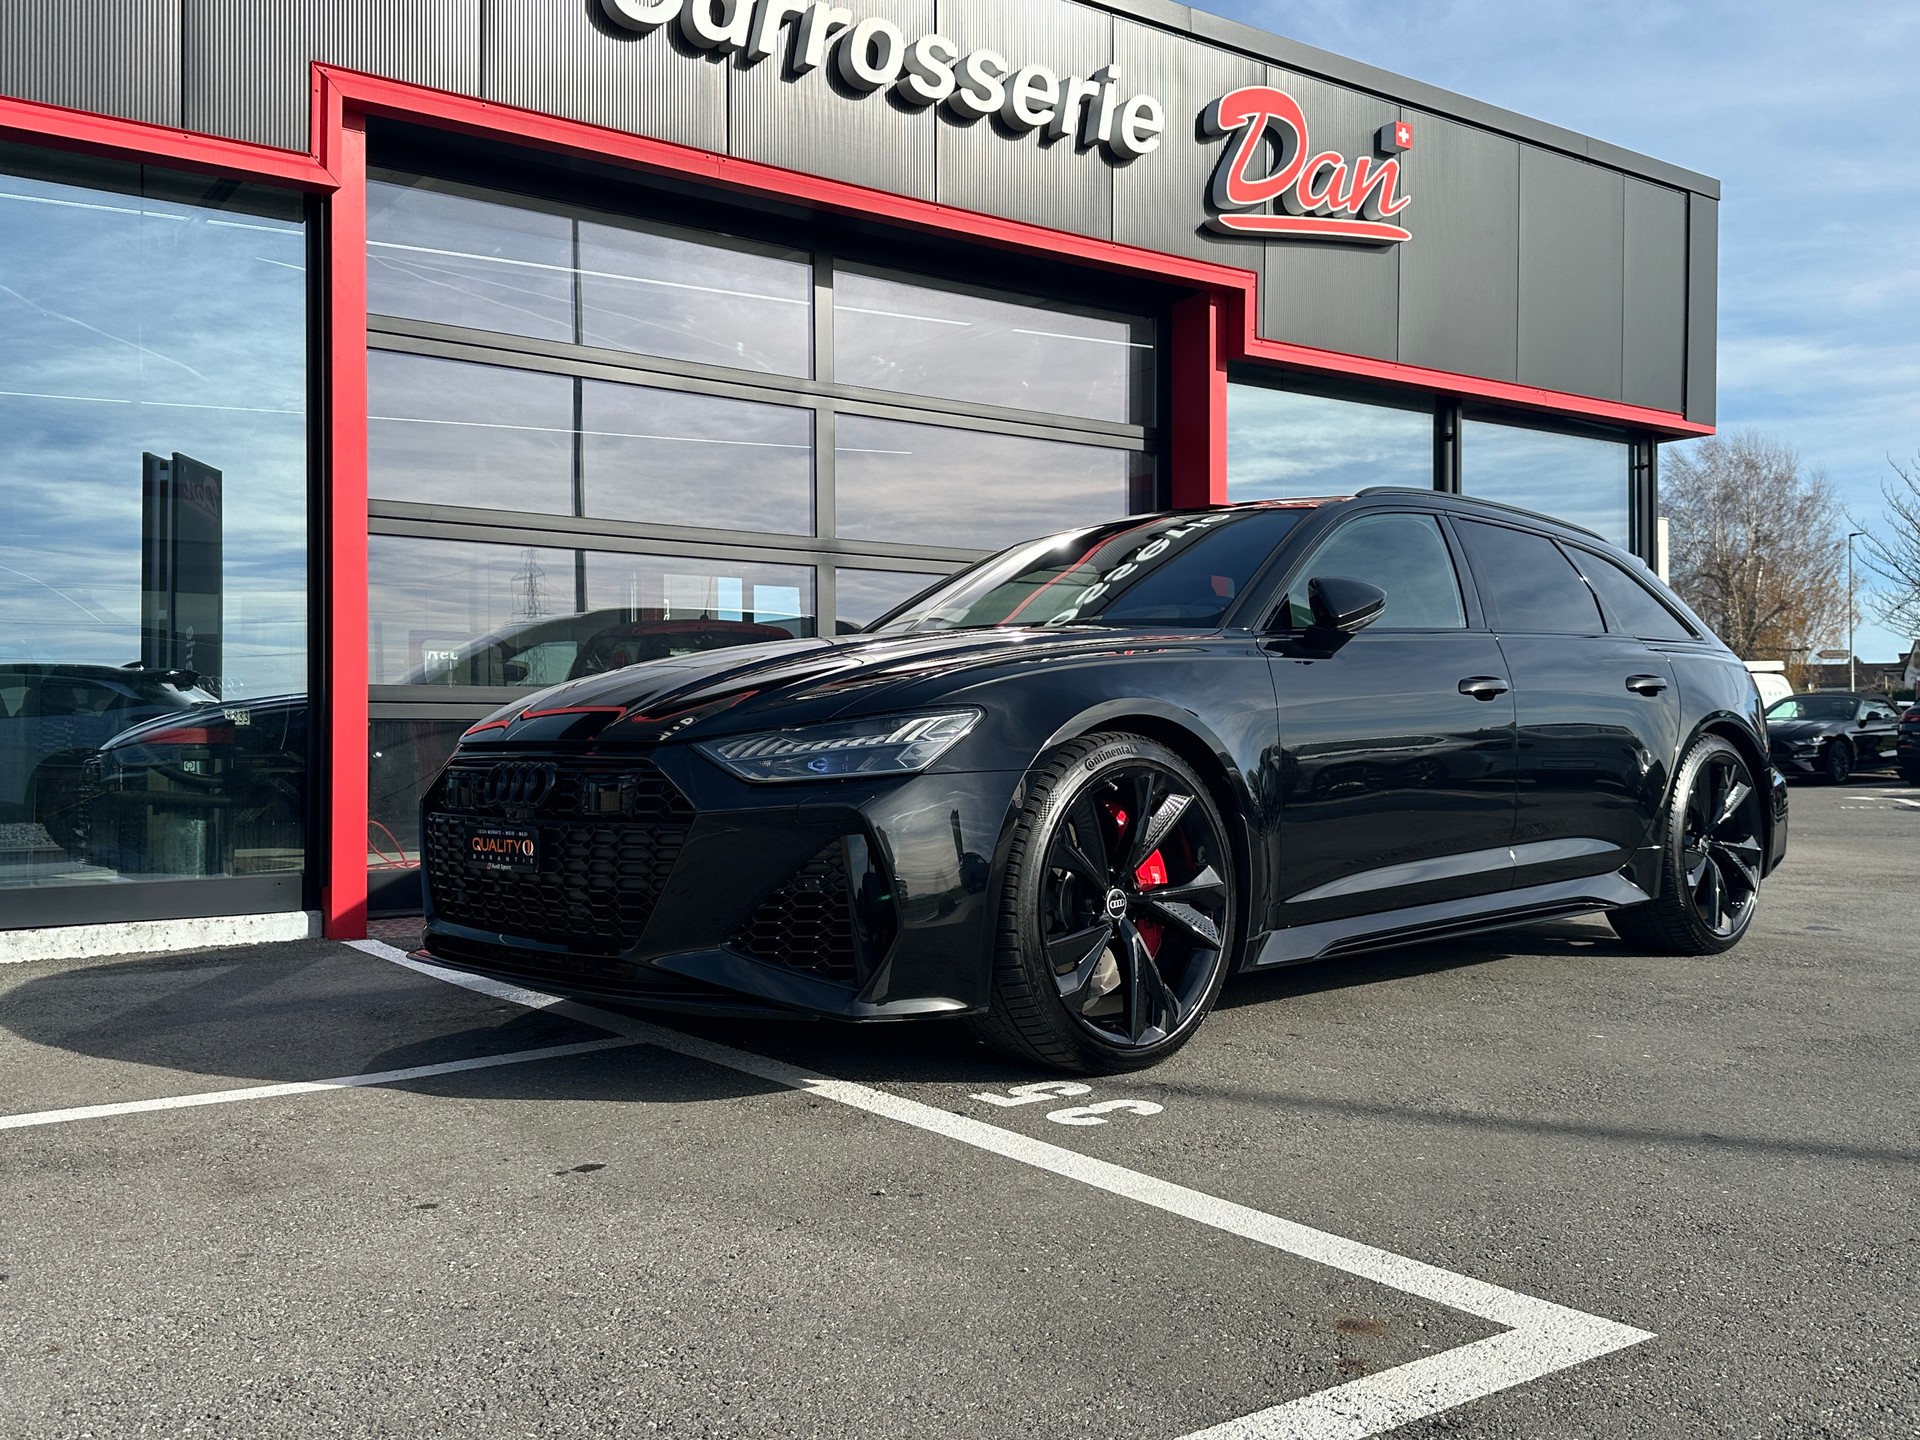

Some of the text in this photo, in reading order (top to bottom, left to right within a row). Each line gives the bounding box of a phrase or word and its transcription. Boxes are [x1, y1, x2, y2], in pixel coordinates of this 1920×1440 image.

[598, 0, 1164, 156] arrosserie
[1217, 85, 1412, 217] Dan
[1084, 744, 1134, 771] Continental
[472, 837, 521, 854] QUALITY
